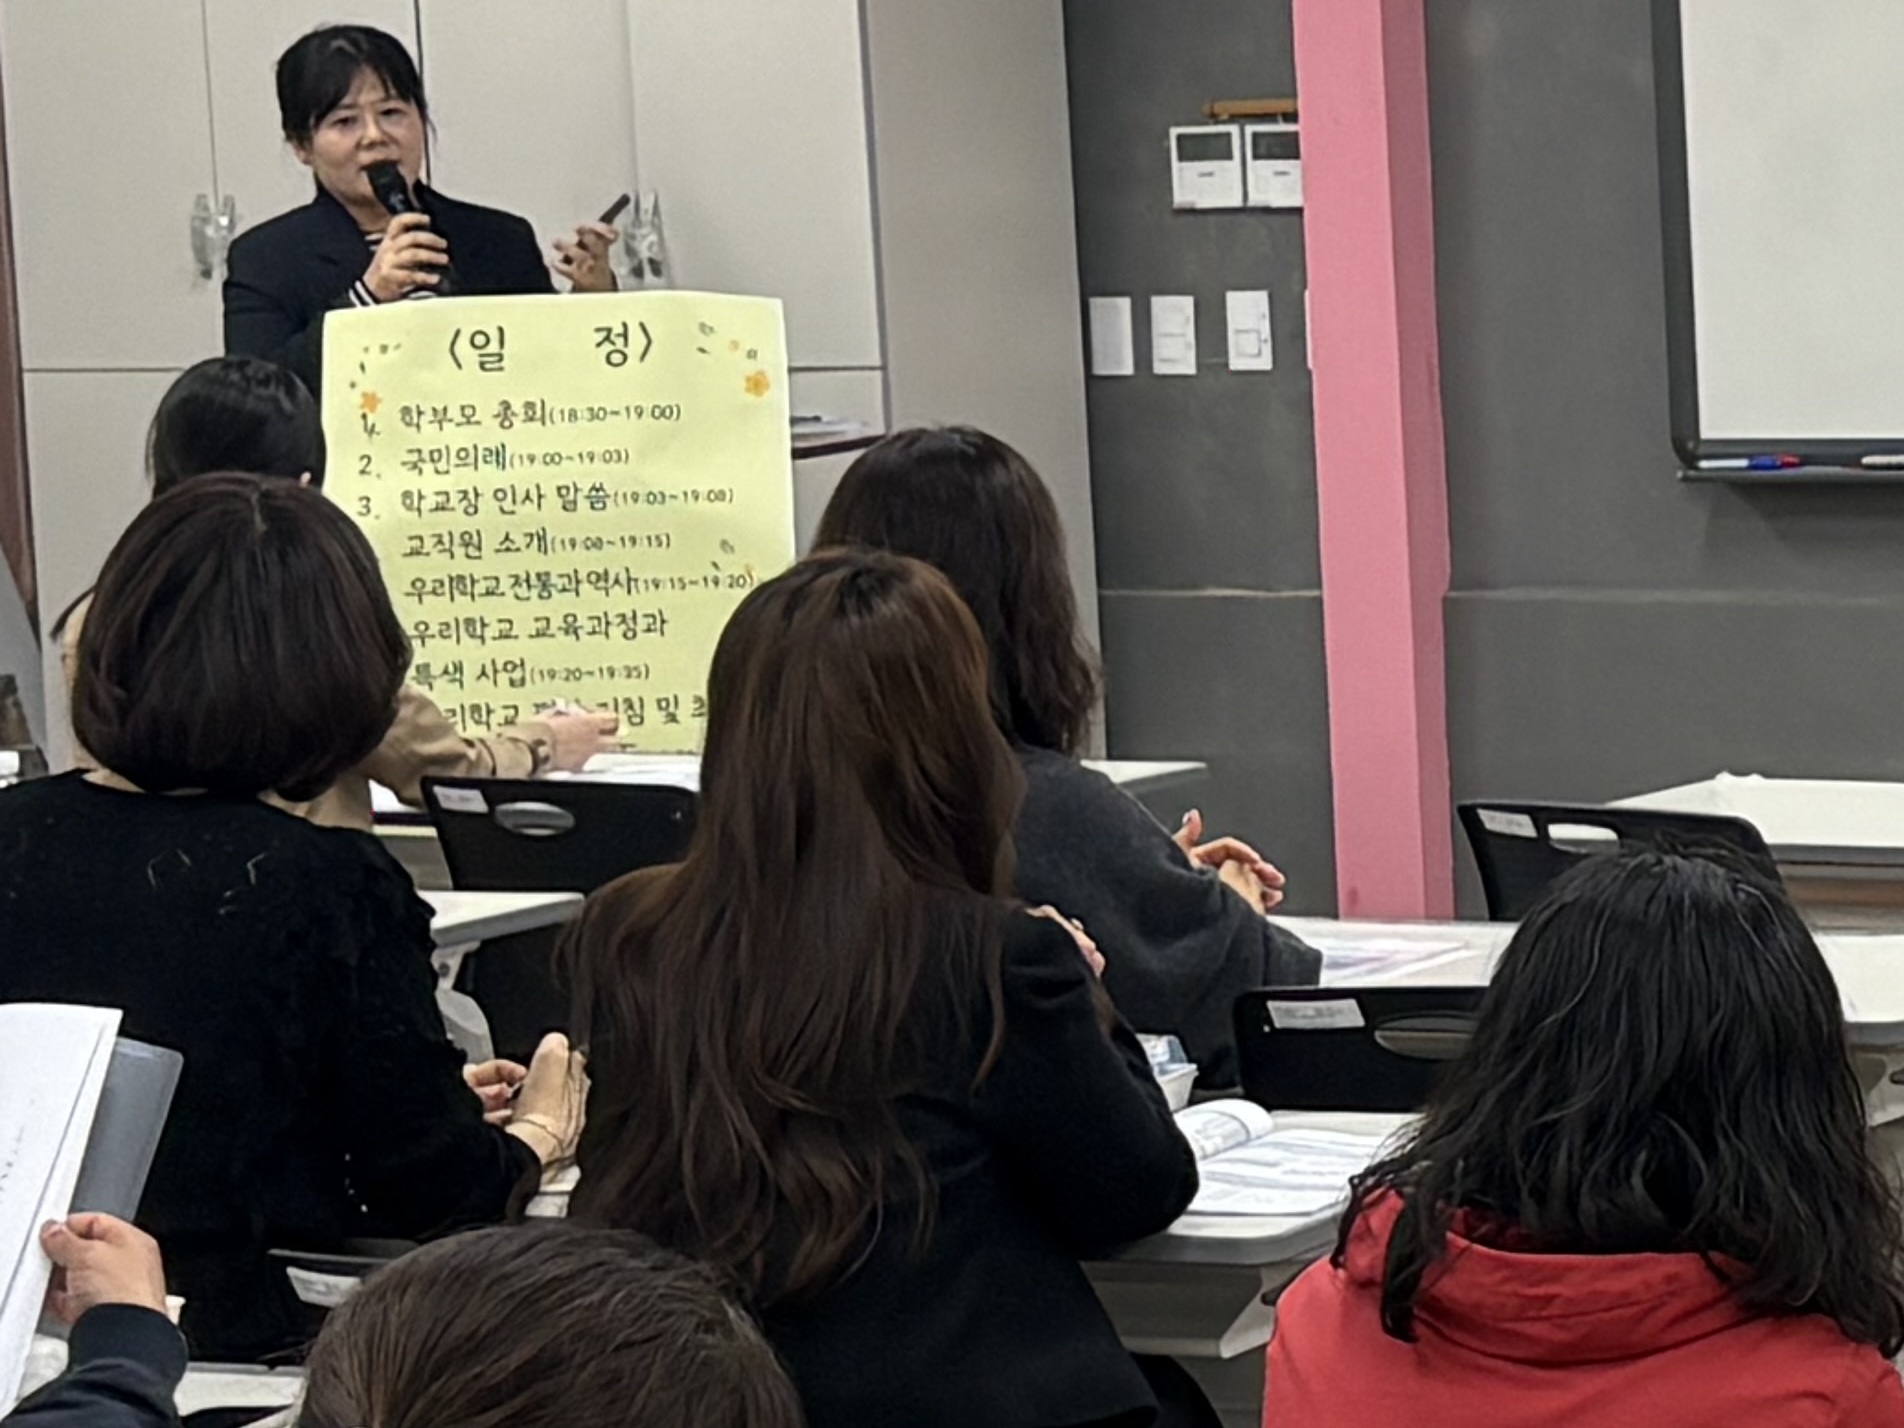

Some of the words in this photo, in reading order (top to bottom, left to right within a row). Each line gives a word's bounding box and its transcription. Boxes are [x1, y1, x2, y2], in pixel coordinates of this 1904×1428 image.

[399, 403, 483, 433] 학부모
[400, 485, 483, 518] 학교장
[493, 483, 546, 516] 인사
[401, 528, 483, 561] 교직원
[410, 615, 519, 648] 우리학교
[528, 608, 668, 641] 교육과정과
[443, 701, 520, 733] 리학교
[655, 693, 681, 726] 및
